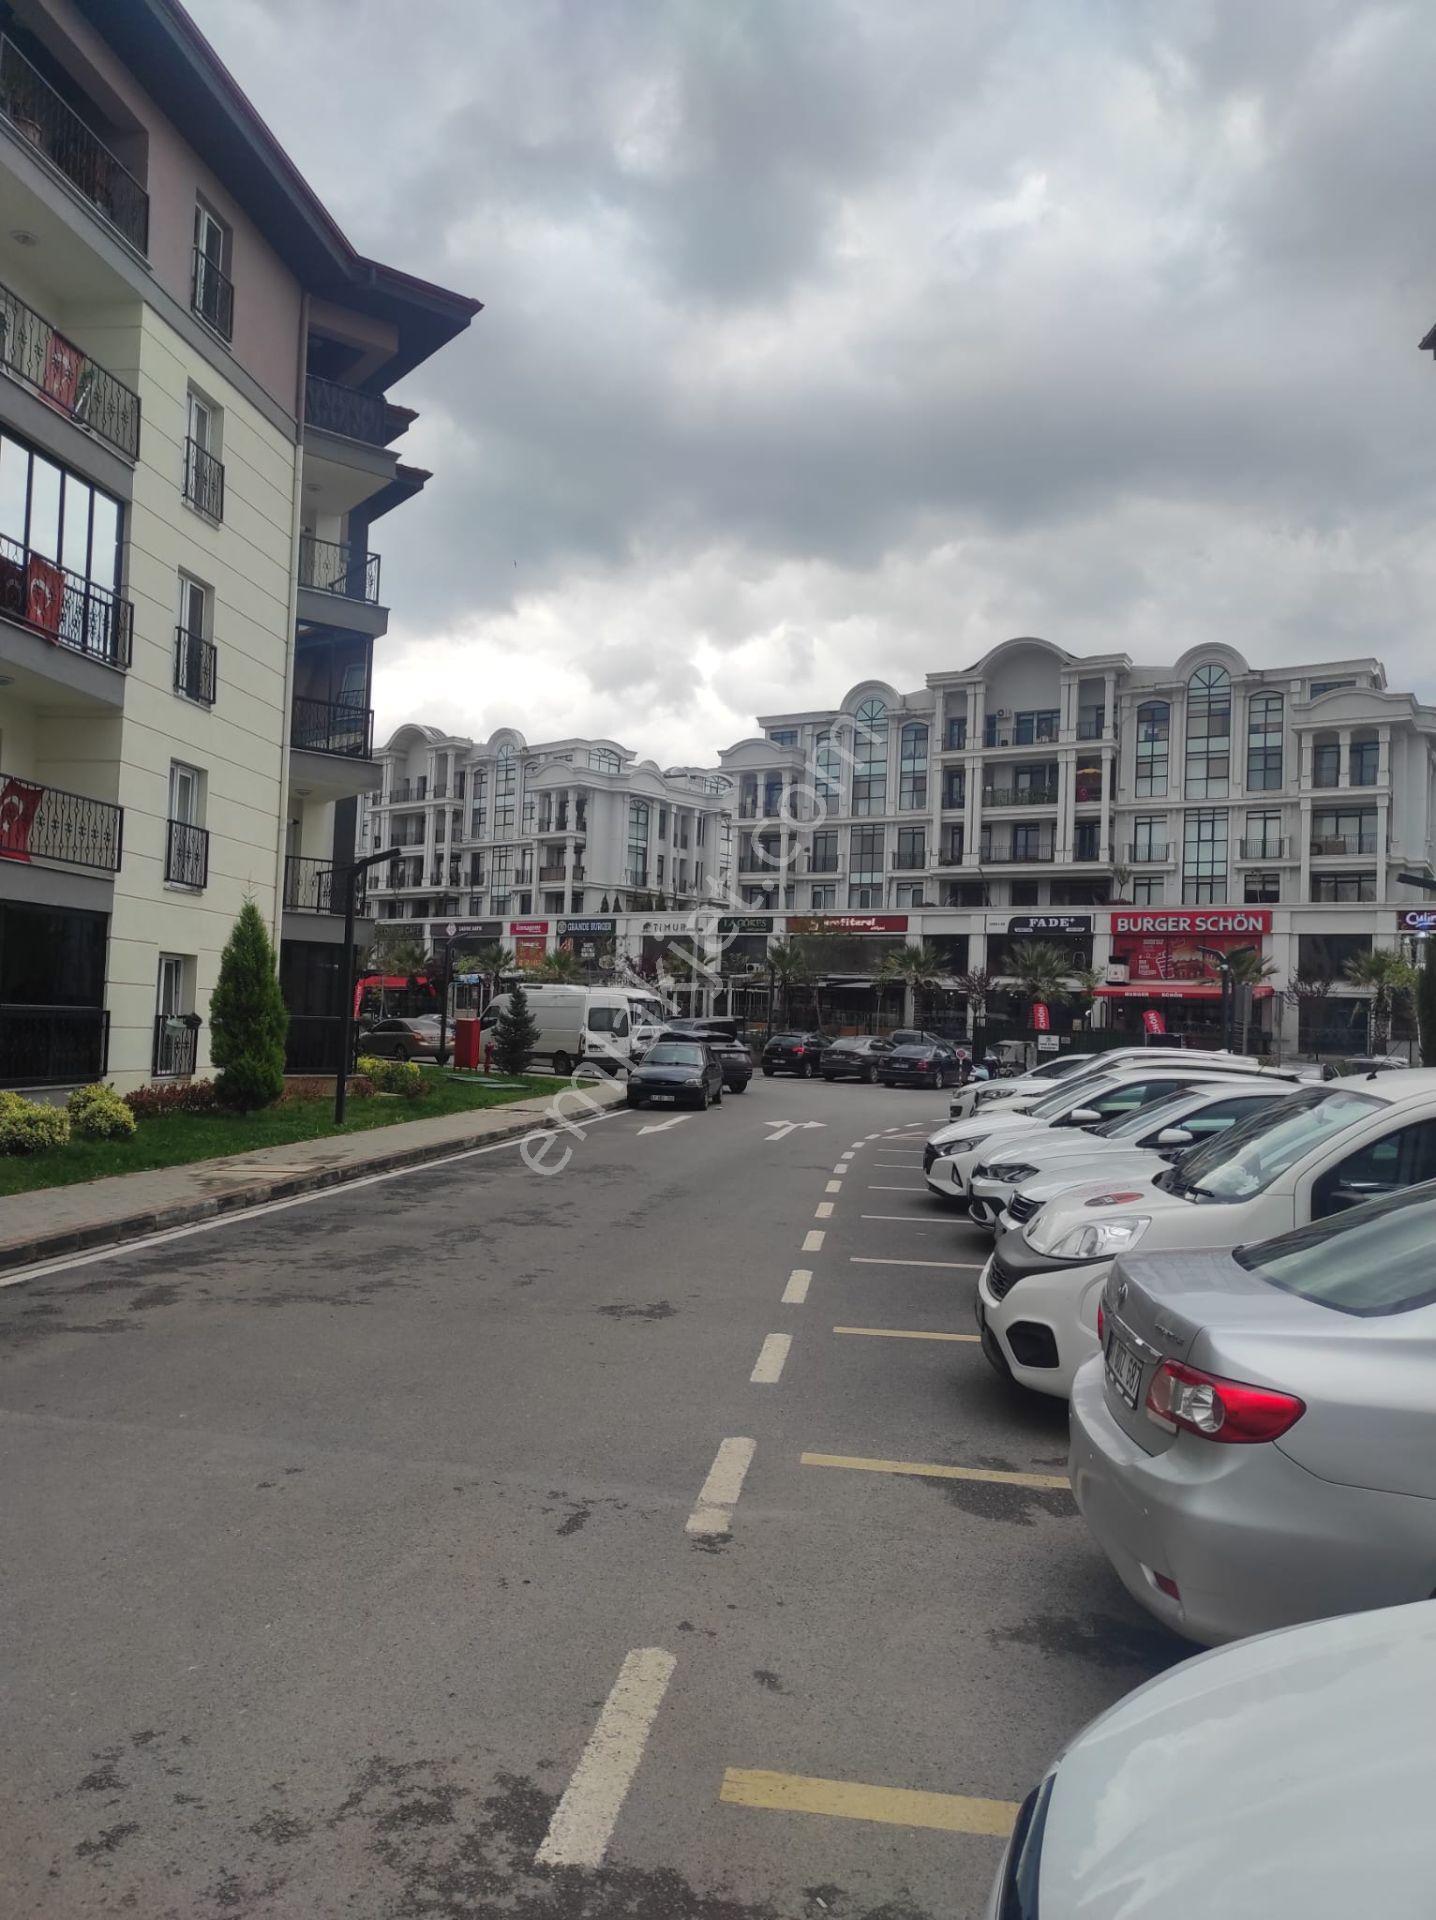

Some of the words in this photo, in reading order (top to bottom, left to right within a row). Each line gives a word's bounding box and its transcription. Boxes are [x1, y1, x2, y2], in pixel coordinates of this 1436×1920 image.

[1029, 918, 1069, 928] FADE
[1117, 917, 1191, 932] BURGER
[1195, 914, 1263, 931] SCHÖN
